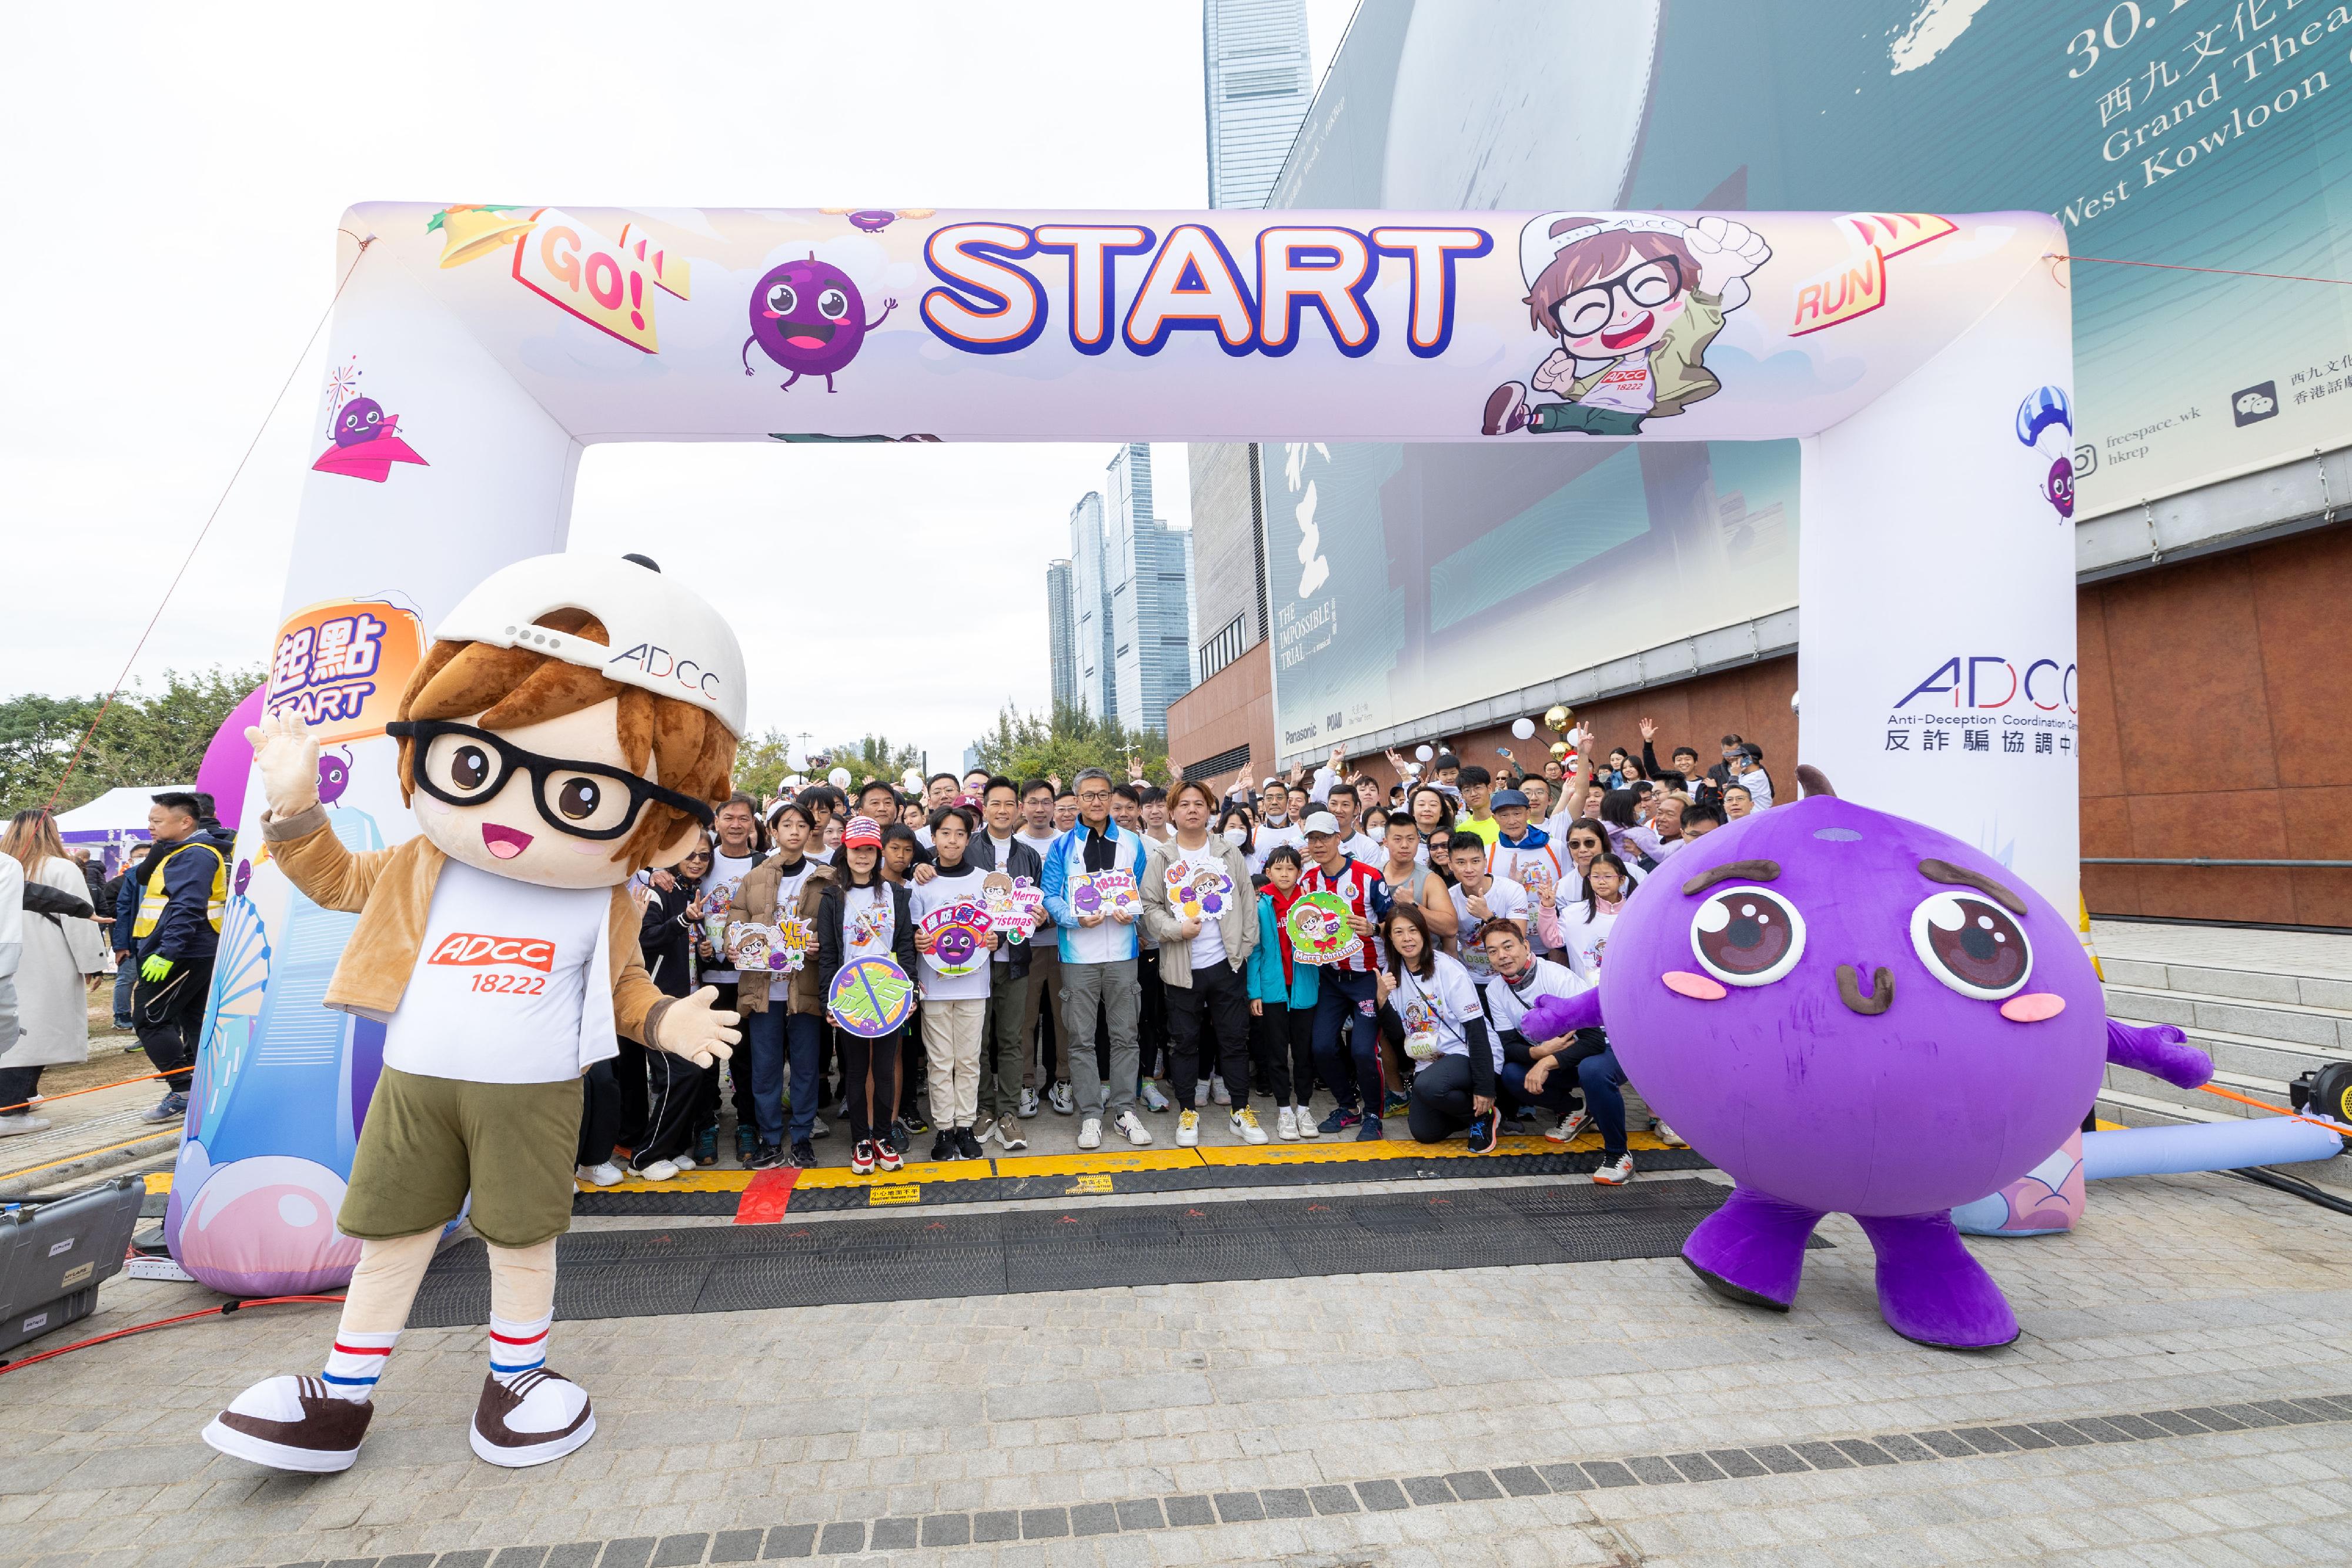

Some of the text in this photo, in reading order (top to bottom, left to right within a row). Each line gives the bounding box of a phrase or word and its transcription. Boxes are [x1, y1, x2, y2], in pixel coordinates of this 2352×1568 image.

[2103, 72, 2221, 162] Grand
[2053, 70, 2331, 229] West Kowloon
[540, 225, 645, 330] GO!
[920, 222, 1494, 358] START
[1794, 260, 1874, 325] RUN
[1603, 370, 1646, 382] ADCC
[2106, 406, 2202, 449] freespace_wk
[2108, 444, 2150, 466] hkrep
[1278, 602, 1295, 628] THE
[1280, 601, 1330, 649] IMPOSSIBLE
[268, 613, 387, 705] 起點
[1281, 643, 1305, 670] TRIAL
[609, 643, 720, 700] ADCC
[1327, 711, 1342, 732] POAD
[1887, 714, 1996, 728] Anti-Deception
[2002, 715, 2066, 729] Coordination
[1285, 722, 1317, 745] Panasonic
[965, 797, 976, 805] M
[1095, 875, 1130, 892] 18222
[1012, 890, 1041, 904] Merry
[779, 921, 803, 941] YE
[433, 936, 550, 962] ADCC
[1295, 941, 1362, 963] Merry Christmas
[472, 974, 546, 995] 18222
[1411, 1044, 1432, 1055] D010
[65, 1268, 88, 1280] MYLAPS
